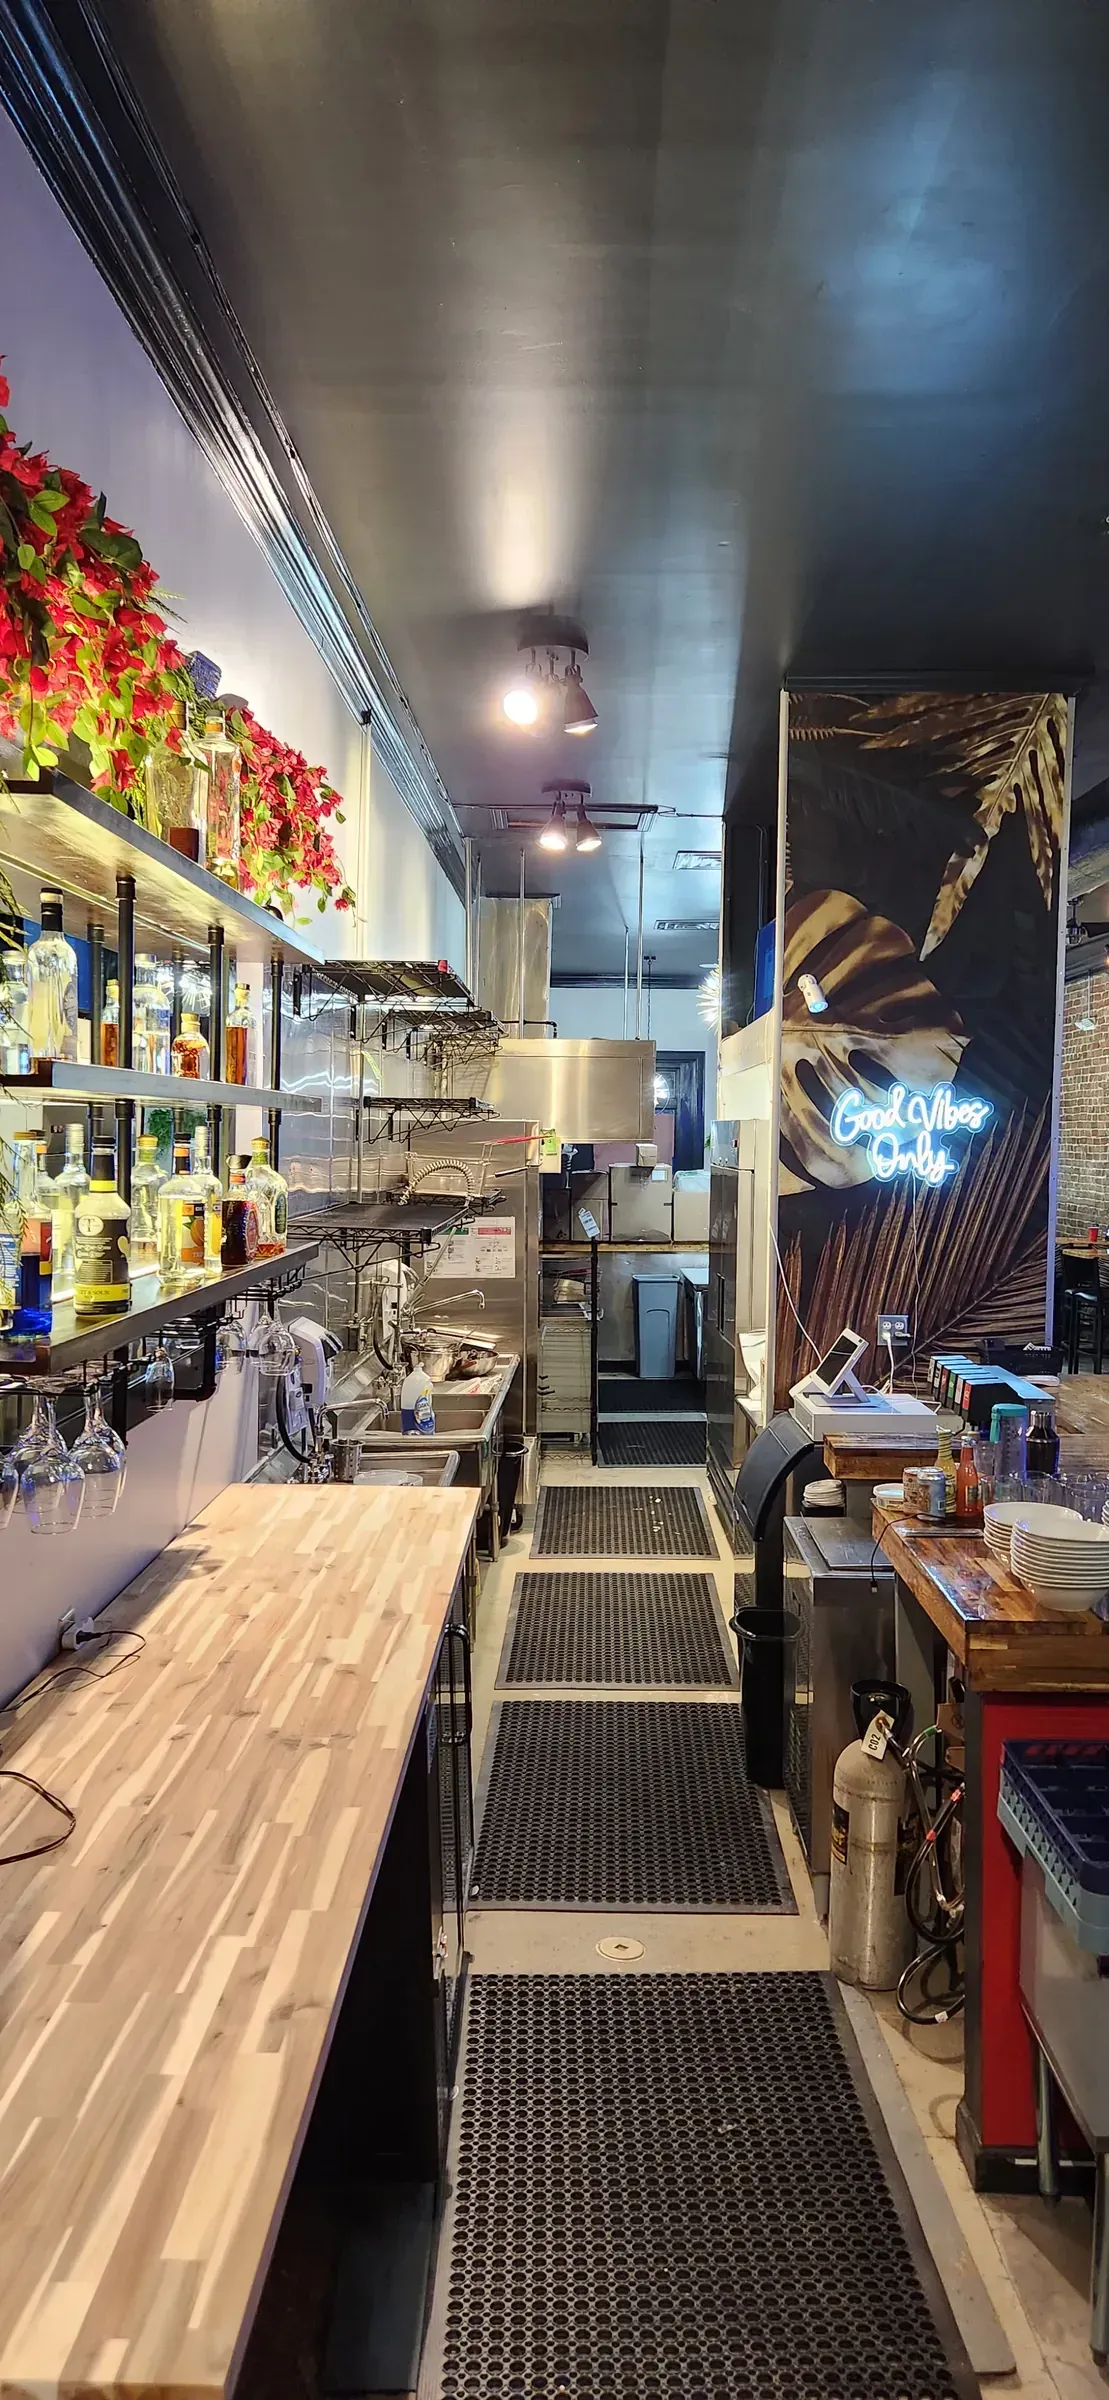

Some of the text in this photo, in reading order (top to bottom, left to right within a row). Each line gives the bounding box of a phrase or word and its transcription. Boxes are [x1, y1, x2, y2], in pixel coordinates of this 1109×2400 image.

[834, 1086, 989, 1142] Good Vibes
[872, 1130, 954, 1183] Only
[867, 1733, 881, 1751] CO2
